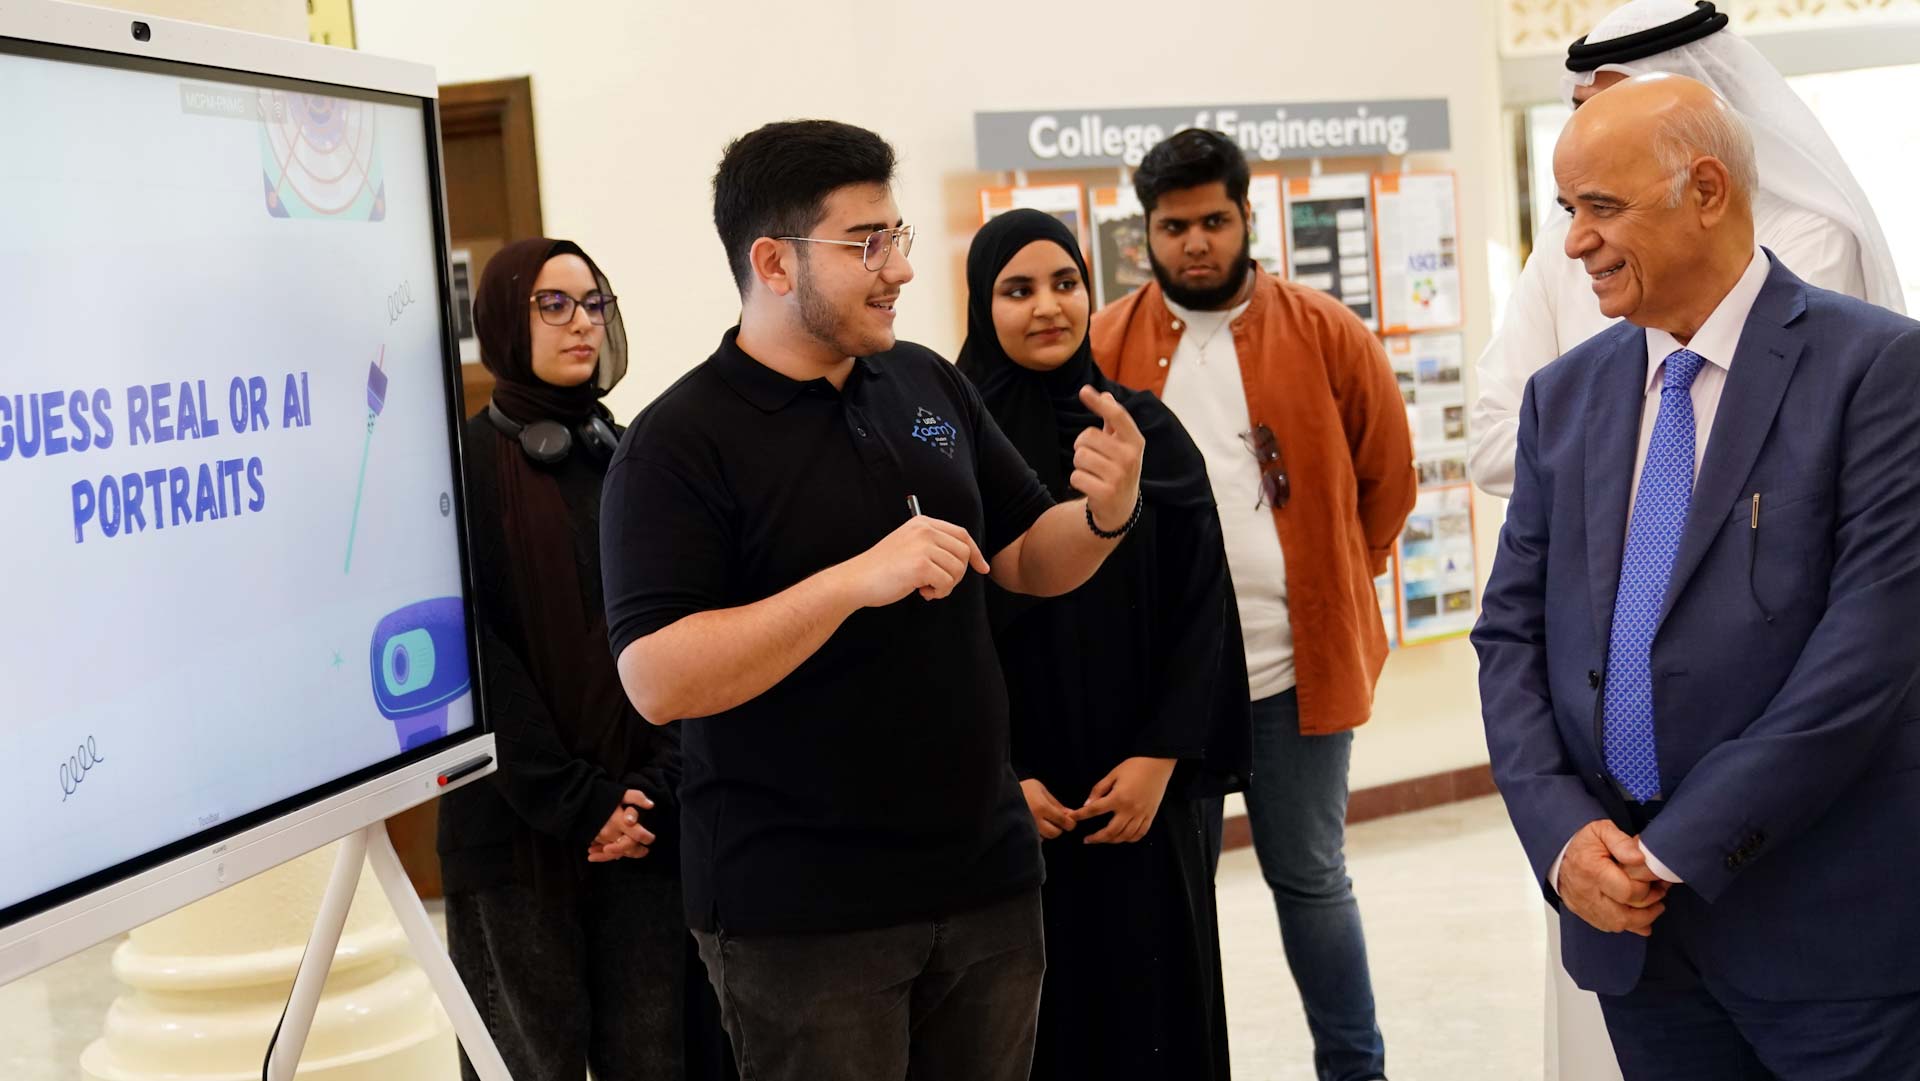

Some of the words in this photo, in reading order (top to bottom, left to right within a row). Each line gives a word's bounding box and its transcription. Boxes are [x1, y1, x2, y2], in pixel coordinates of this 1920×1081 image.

[1028, 113, 1165, 167] College
[1215, 106, 1408, 161] Engineering
[0, 387, 114, 461] GUESS
[126, 379, 219, 446] REAL
[229, 375, 270, 434] OR
[282, 371, 312, 429] AI
[920, 425, 950, 437] acm
[71, 456, 266, 544] PORTRAITS
